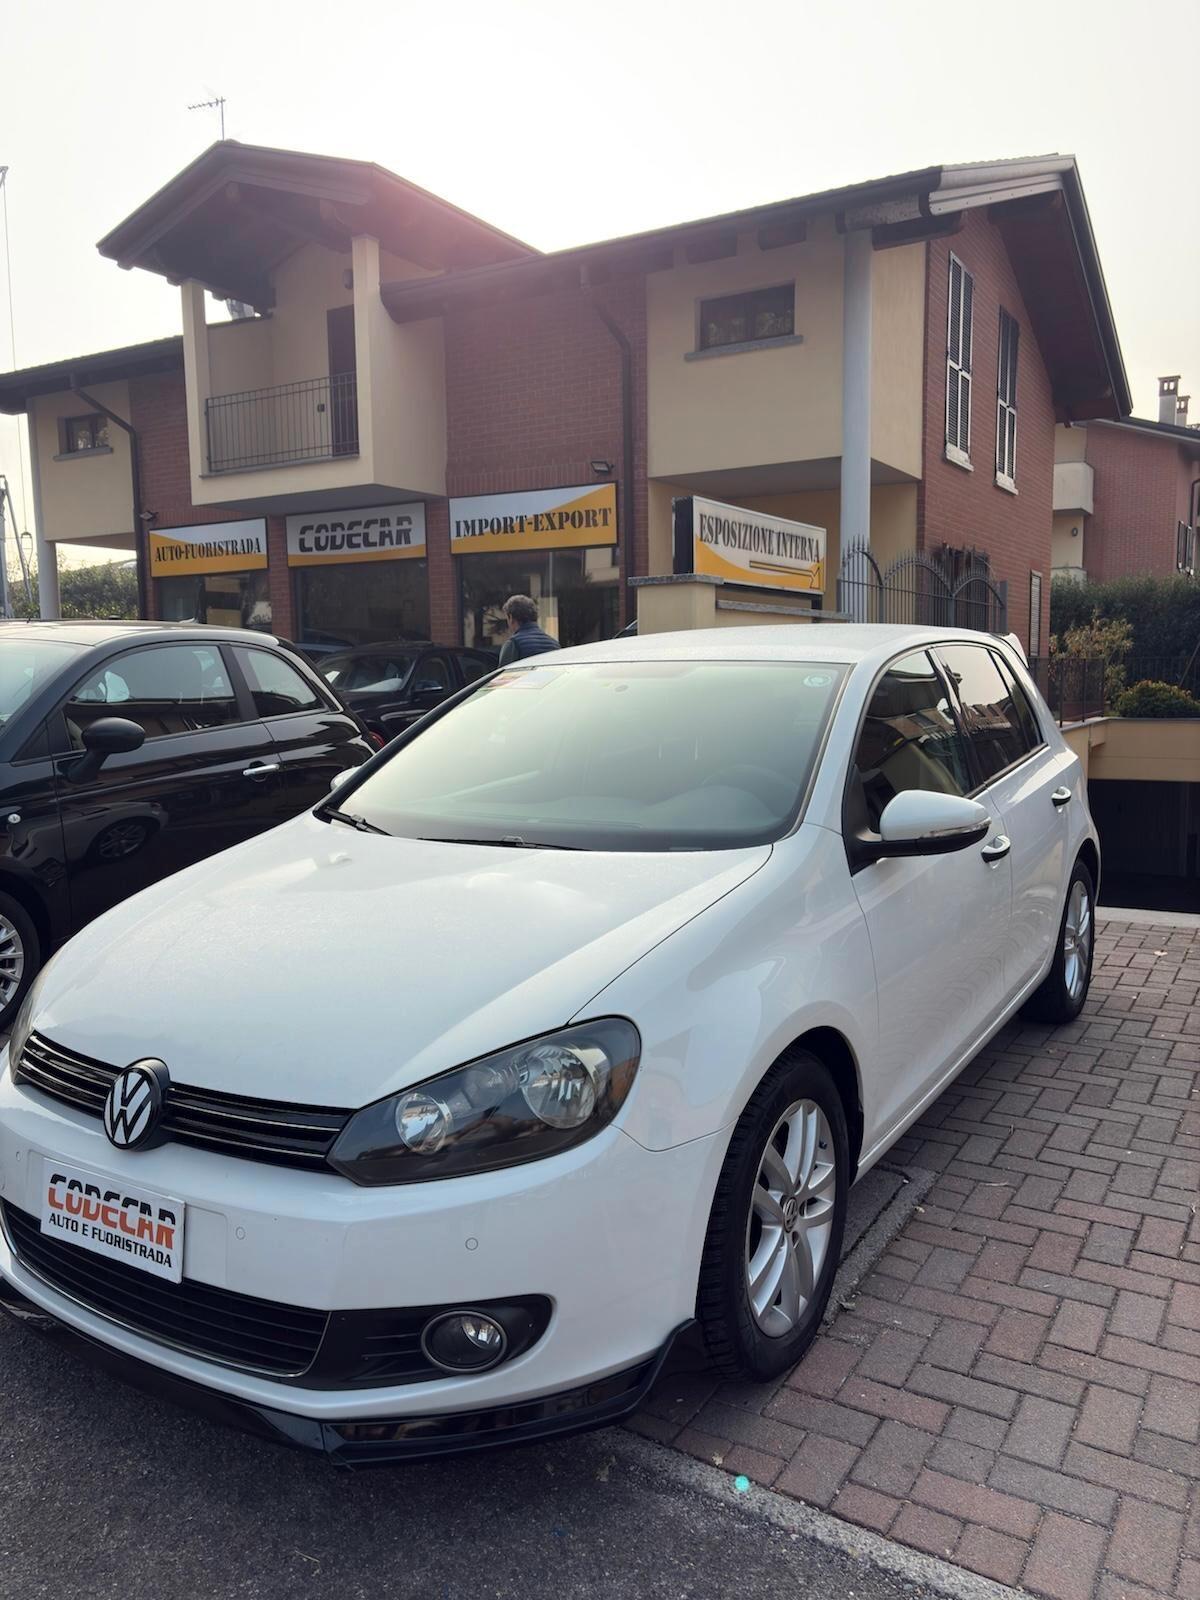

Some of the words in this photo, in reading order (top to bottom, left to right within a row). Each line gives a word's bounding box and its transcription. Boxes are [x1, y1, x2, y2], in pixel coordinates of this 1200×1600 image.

[298, 515, 413, 553] CODECAR
[455, 508, 612, 538] IMPORT-EXPORT
[699, 513, 774, 555] ESPOSIZIONE
[775, 531, 820, 563] INTERNA
[155, 537, 261, 562] AUTO-FUORISTRADA
[48, 1173, 176, 1250] CODECAR
[48, 1212, 79, 1234] AUTO
[81, 1223, 89, 1237] E
[91, 1227, 172, 1268] FUORISTRADA
